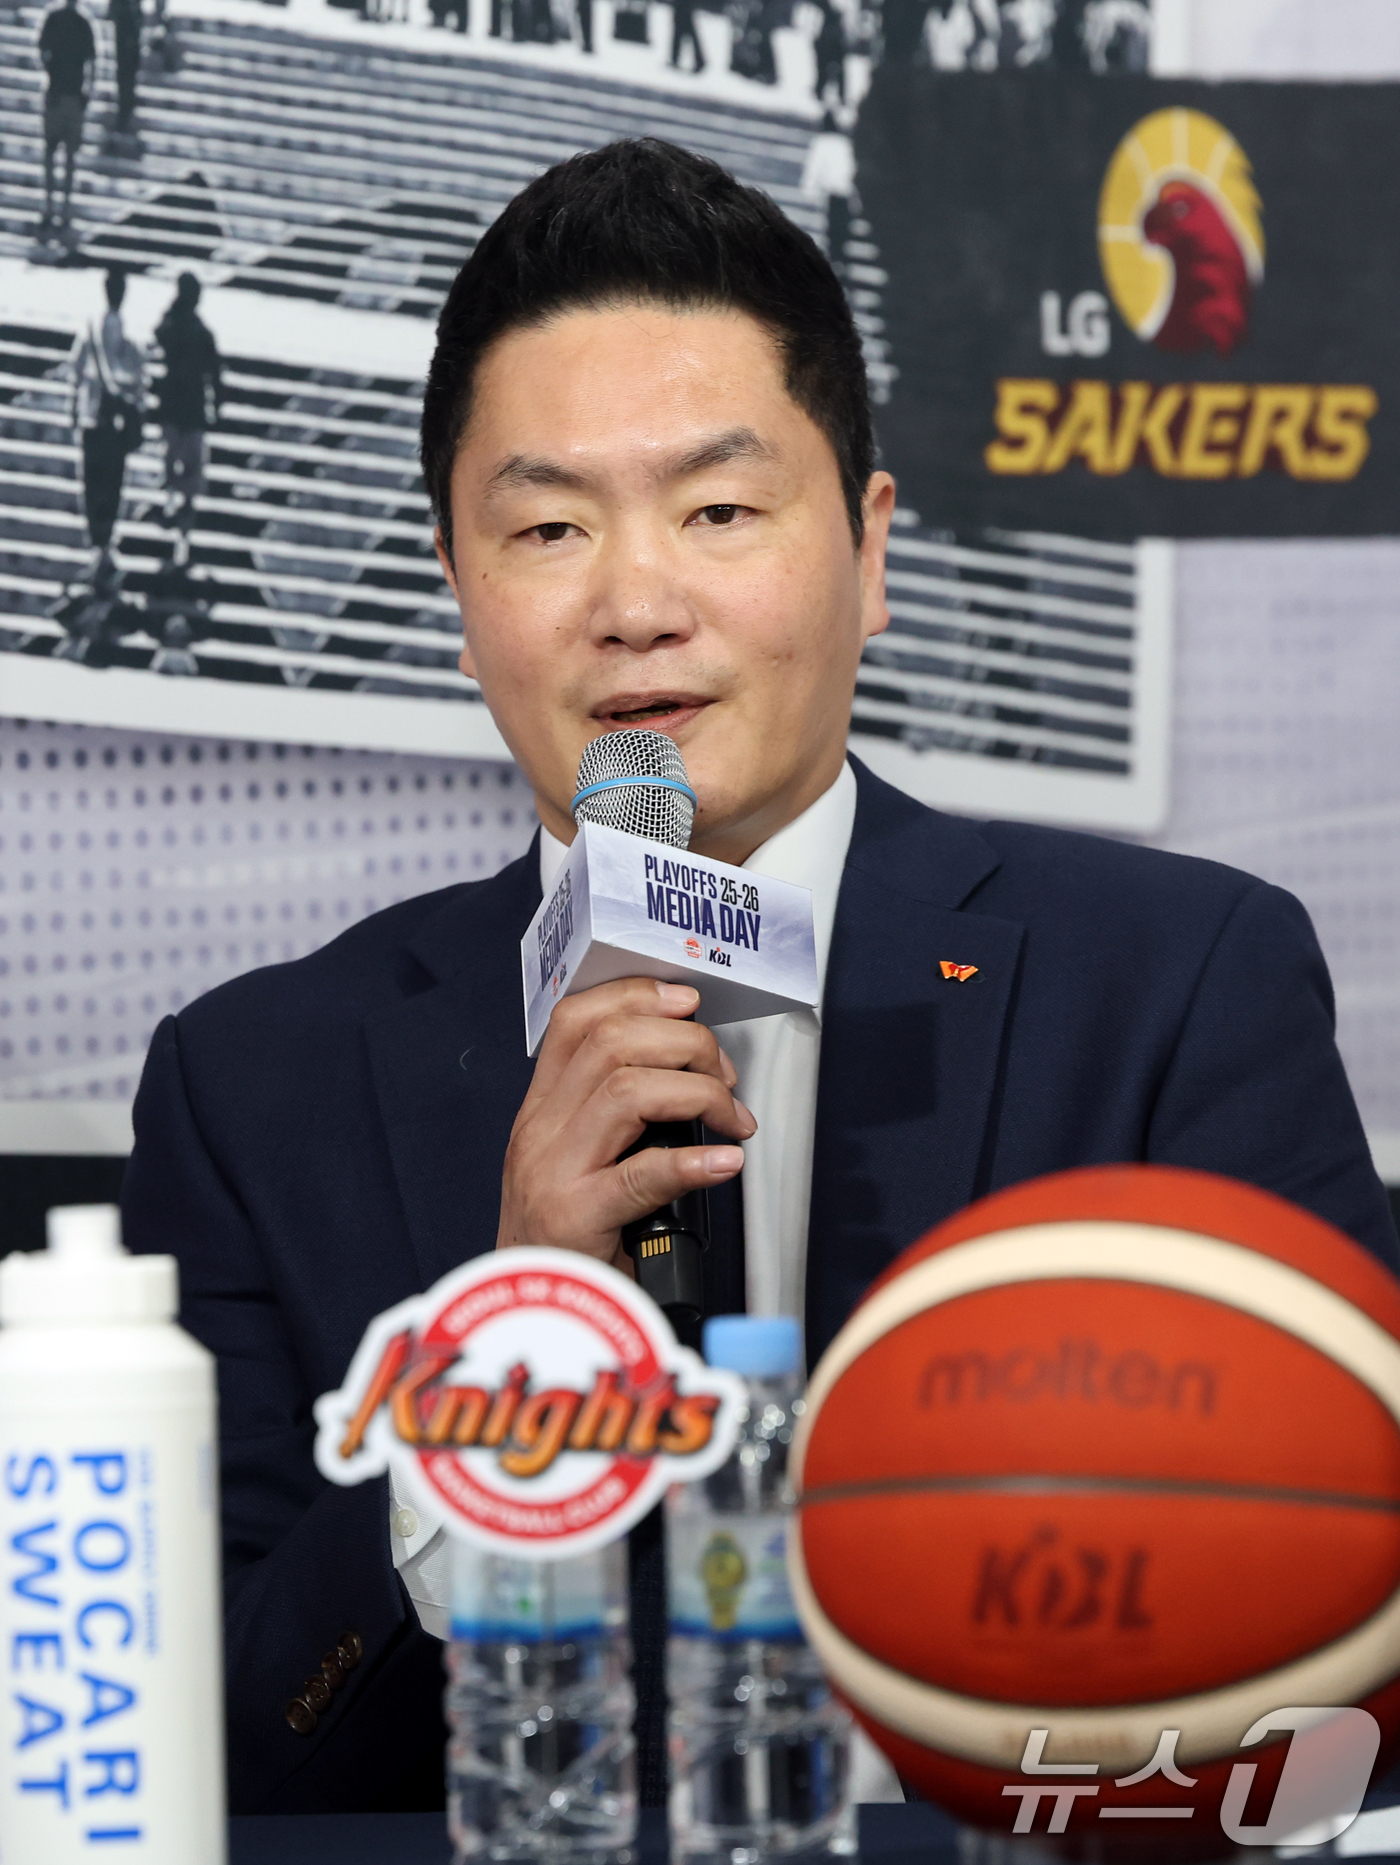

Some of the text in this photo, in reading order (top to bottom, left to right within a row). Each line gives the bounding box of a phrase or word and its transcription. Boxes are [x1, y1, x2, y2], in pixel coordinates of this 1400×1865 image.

[1040, 289, 1111, 357] LG
[984, 376, 1379, 481] SAKERS
[644, 853, 760, 912] PLAYOFFS 25-26
[646, 881, 761, 952] MEDIA DAY
[540, 895, 574, 992] MEDIA DAY
[709, 947, 732, 968] KBL
[339, 1330, 722, 1478] Knights
[918, 1335, 1218, 1419] molten
[971, 1522, 1154, 1630] KBL
[5, 1454, 70, 1812] SWEAT
[72, 1452, 142, 1844] POCARI
